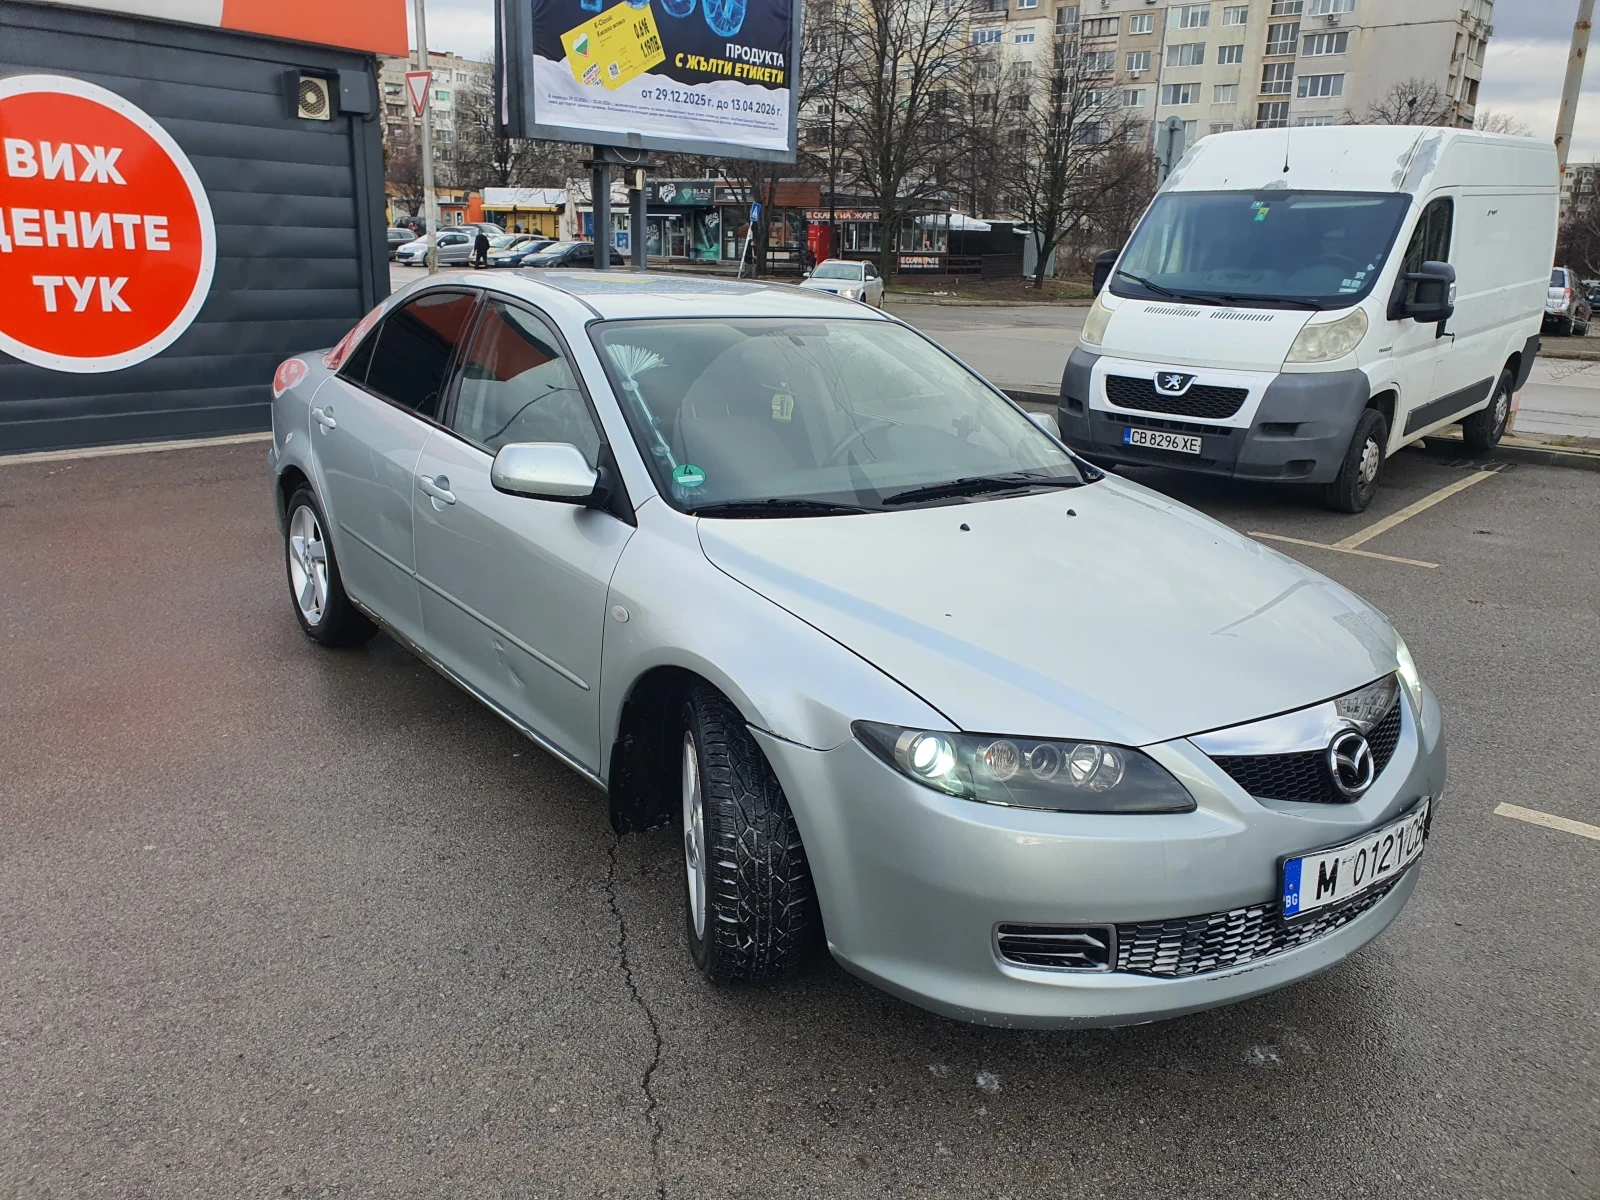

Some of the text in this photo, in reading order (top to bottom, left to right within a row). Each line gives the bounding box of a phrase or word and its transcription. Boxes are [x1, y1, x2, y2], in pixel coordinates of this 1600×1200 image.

[675, 53, 684, 67] С
[685, 54, 733, 75] ЖЪЛТИ
[734, 63, 785, 84] ЕТИКЕТИ
[725, 43, 784, 67] ПРОДУКТА
[641, 89, 652, 99] от
[655, 88, 706, 106] 29.12.2025
[716, 100, 728, 111] до
[731, 99, 776, 116] 13.04.2026
[3, 137, 128, 185] ВИЖ
[854, 211, 872, 220] ЖАР
[31, 275, 132, 312] ТУК
[1131, 430, 1147, 444] CB
[1149, 433, 1179, 449] 8296
[1181, 437, 1199, 452] XE
[683, 465, 694, 475] 4
[1285, 893, 1298, 908] BG
[1315, 856, 1340, 900] M
[1353, 827, 1404, 886] 0121
